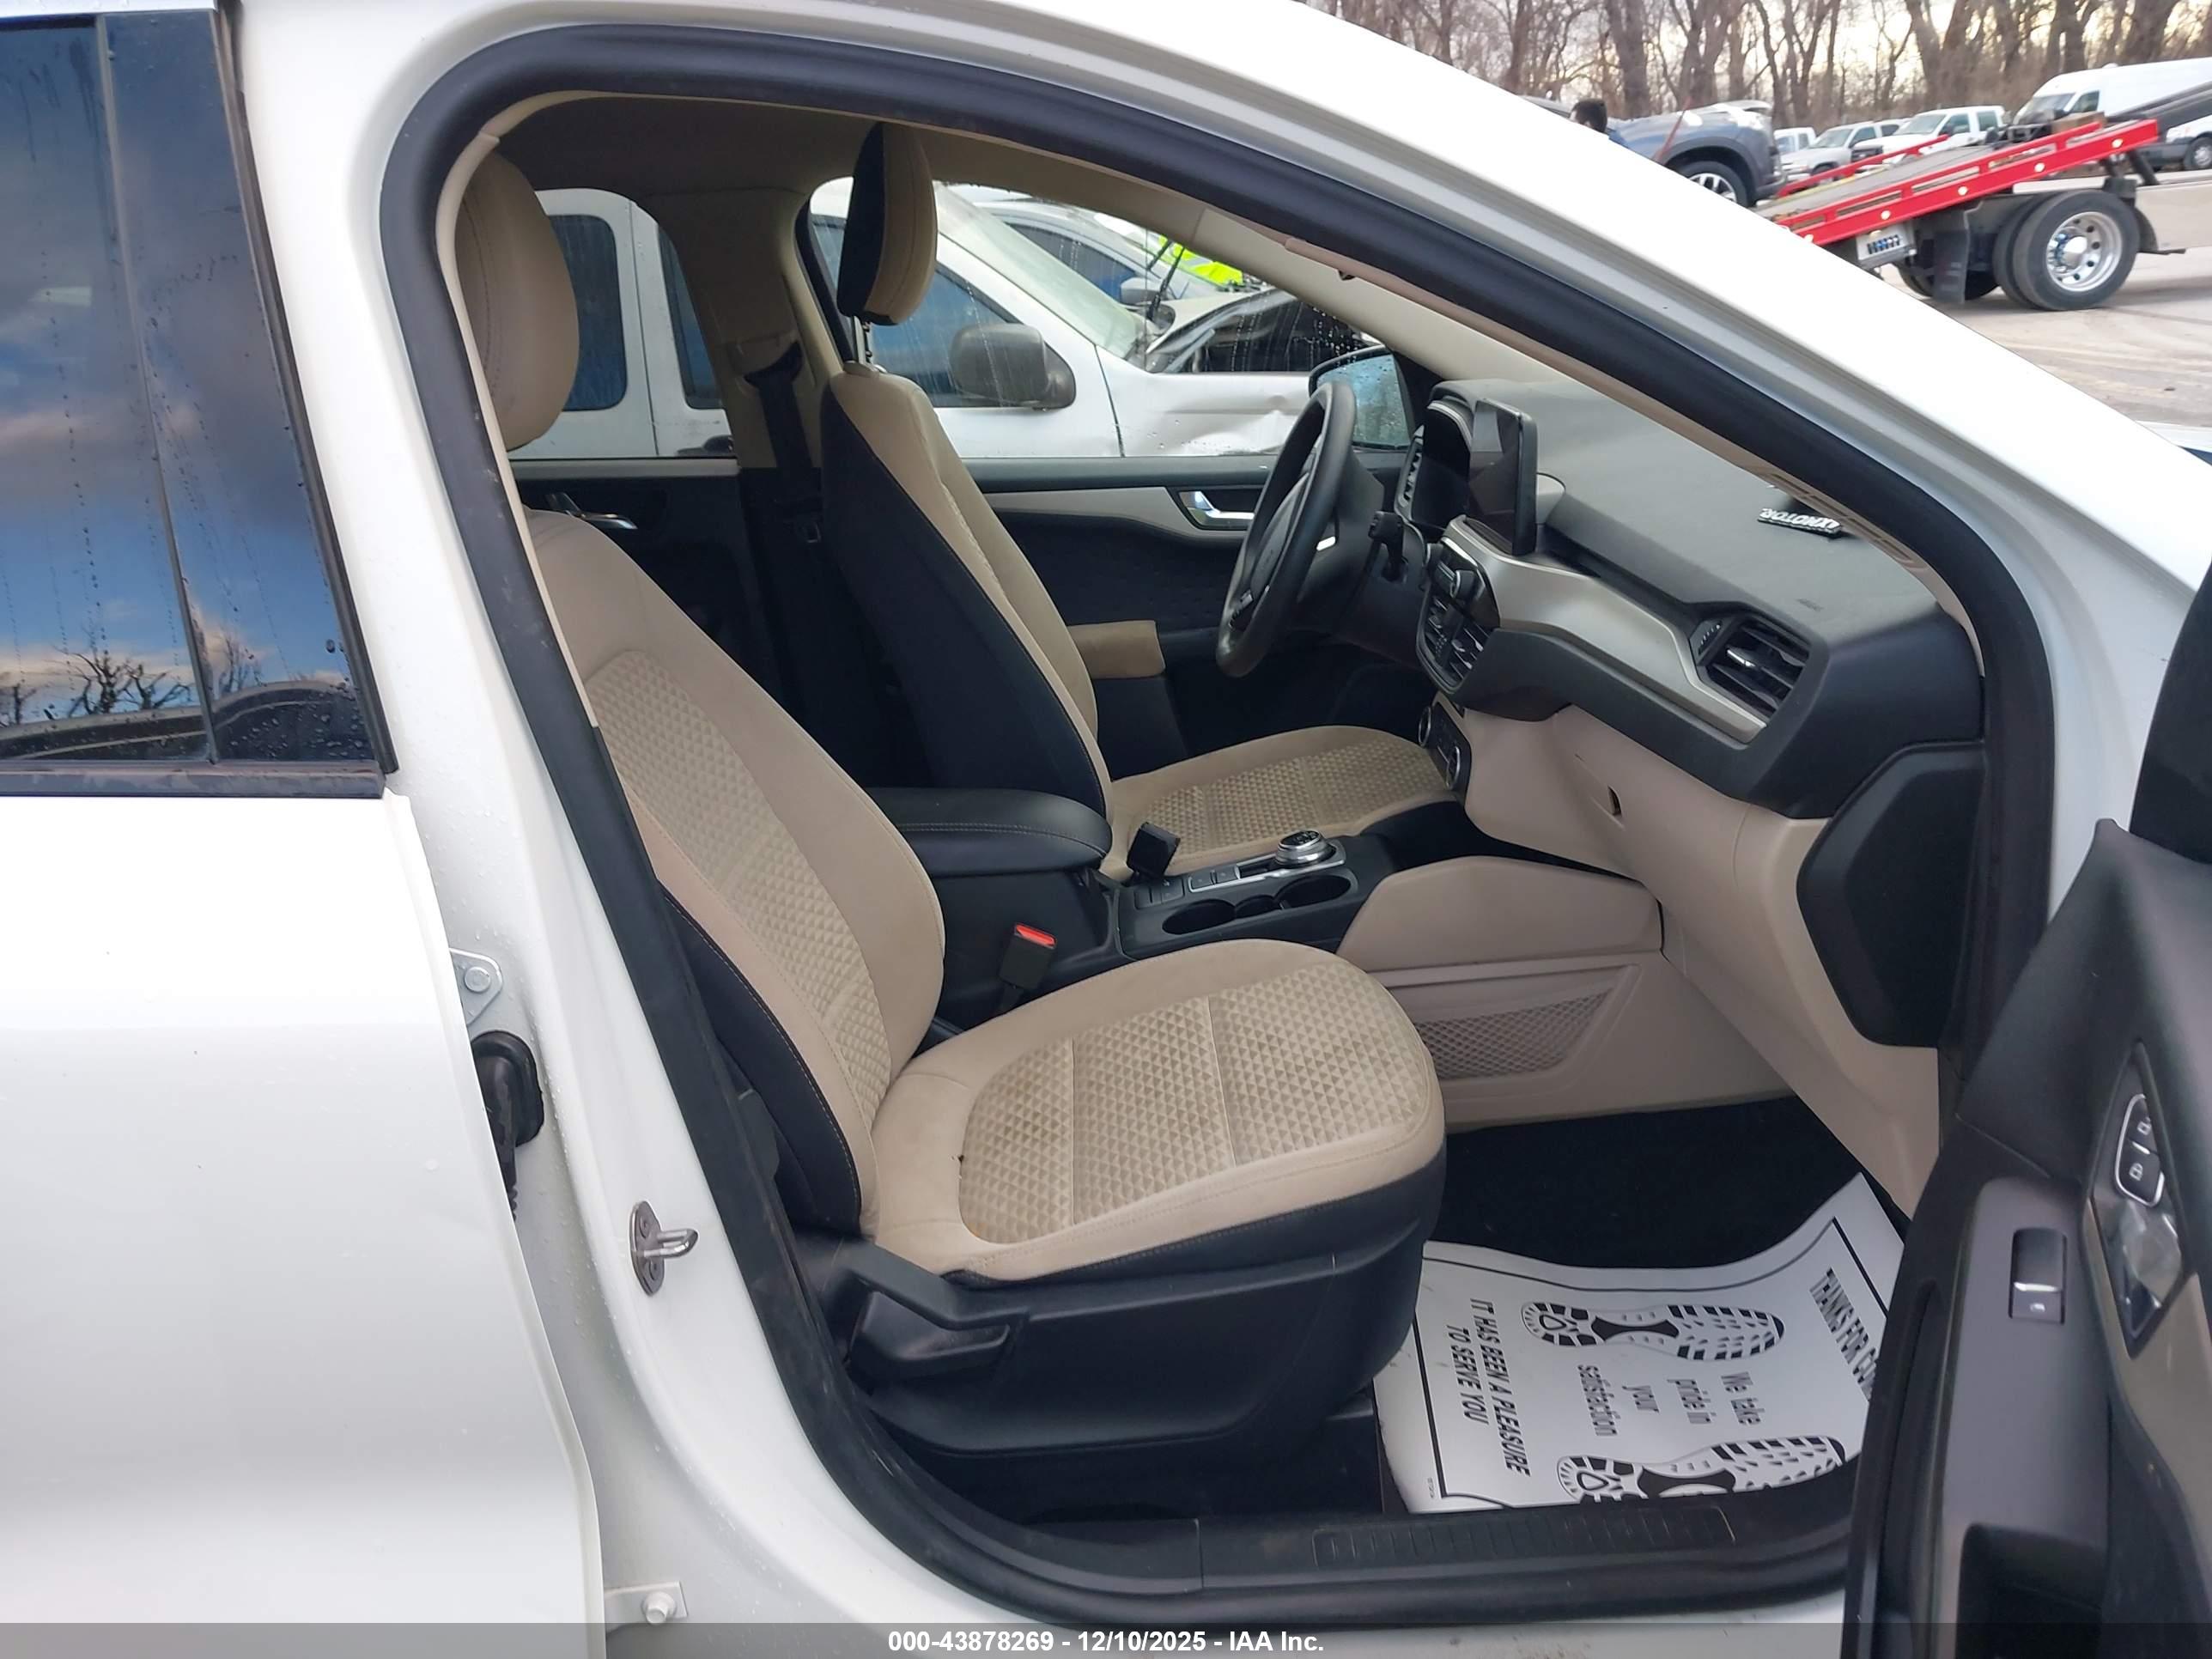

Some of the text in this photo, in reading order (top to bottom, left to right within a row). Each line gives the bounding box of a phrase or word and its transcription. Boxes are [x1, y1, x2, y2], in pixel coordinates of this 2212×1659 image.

[1809, 1267, 1855, 1333] THANKS
[1836, 1317, 1869, 1364] FOR
[1447, 1325, 1489, 1425] TO SERVE YOU
[1470, 1297, 1531, 1476] IT HAS BEEN A PLEASURE
[1577, 1364, 1621, 1437] satisfaction
[1621, 1385, 1659, 1413] your
[1667, 1379, 1717, 1425] pride in
[1721, 1372, 1765, 1425] We take
